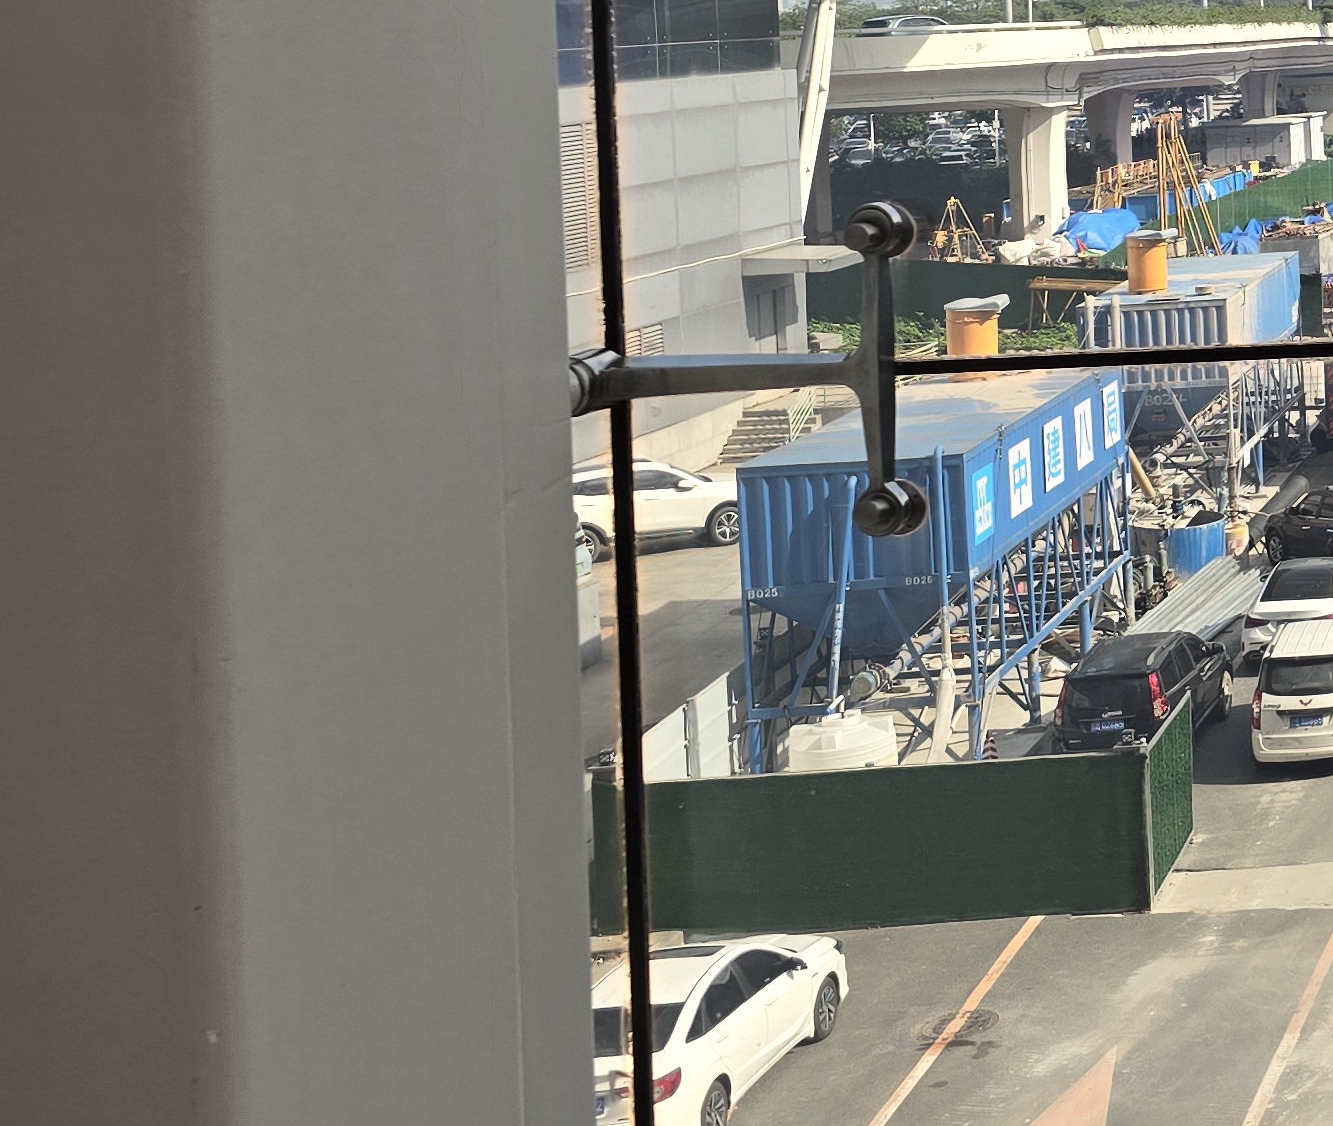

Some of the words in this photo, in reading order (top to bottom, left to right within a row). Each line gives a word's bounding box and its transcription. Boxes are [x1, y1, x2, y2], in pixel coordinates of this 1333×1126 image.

[1012, 388, 1119, 507] 中建八局
[747, 587, 779, 599] B025
